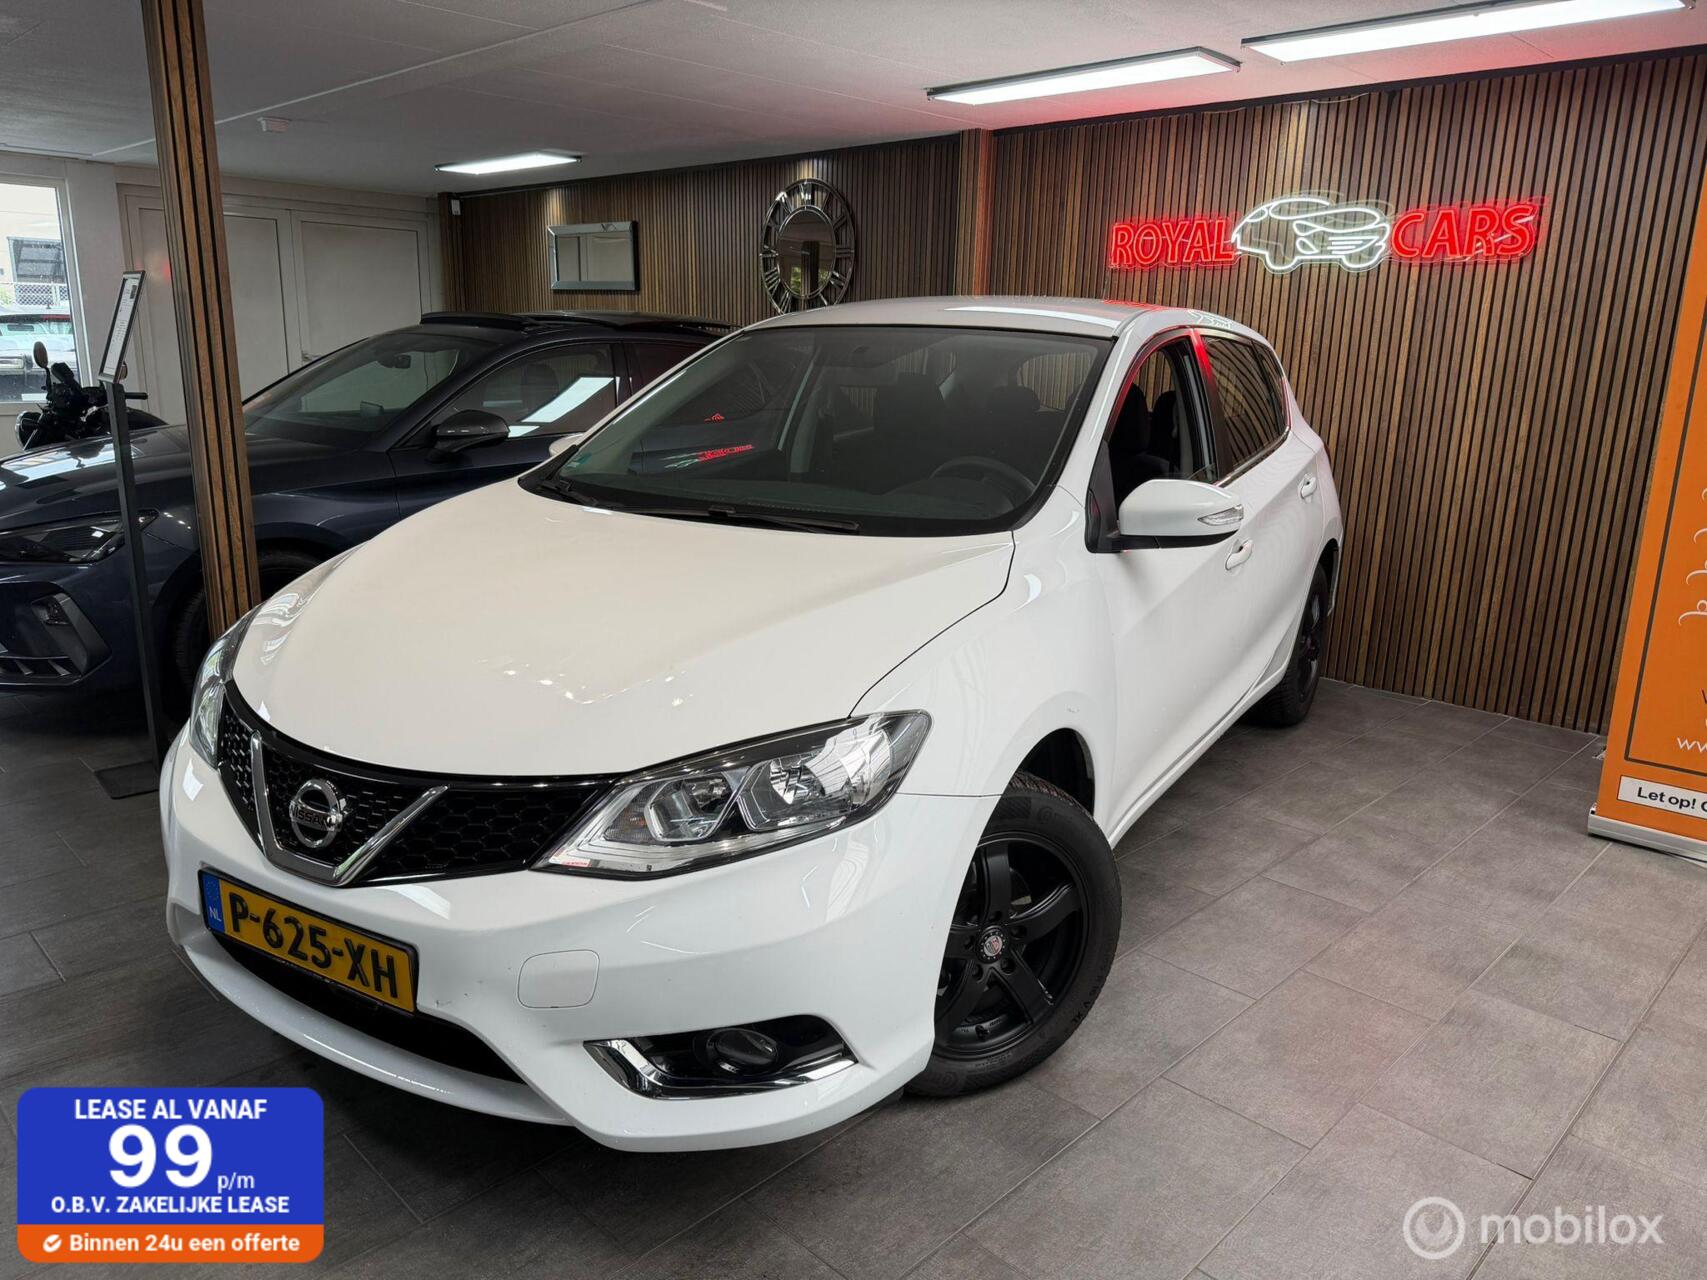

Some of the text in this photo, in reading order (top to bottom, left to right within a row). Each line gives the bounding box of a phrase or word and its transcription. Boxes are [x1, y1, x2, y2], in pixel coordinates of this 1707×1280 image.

[1110, 203, 1537, 266] ROYAL CARS
[1637, 786, 1666, 803] Let
[1667, 795, 1697, 810] op!
[208, 906, 223, 922] NL
[229, 891, 399, 999] P-625-XH
